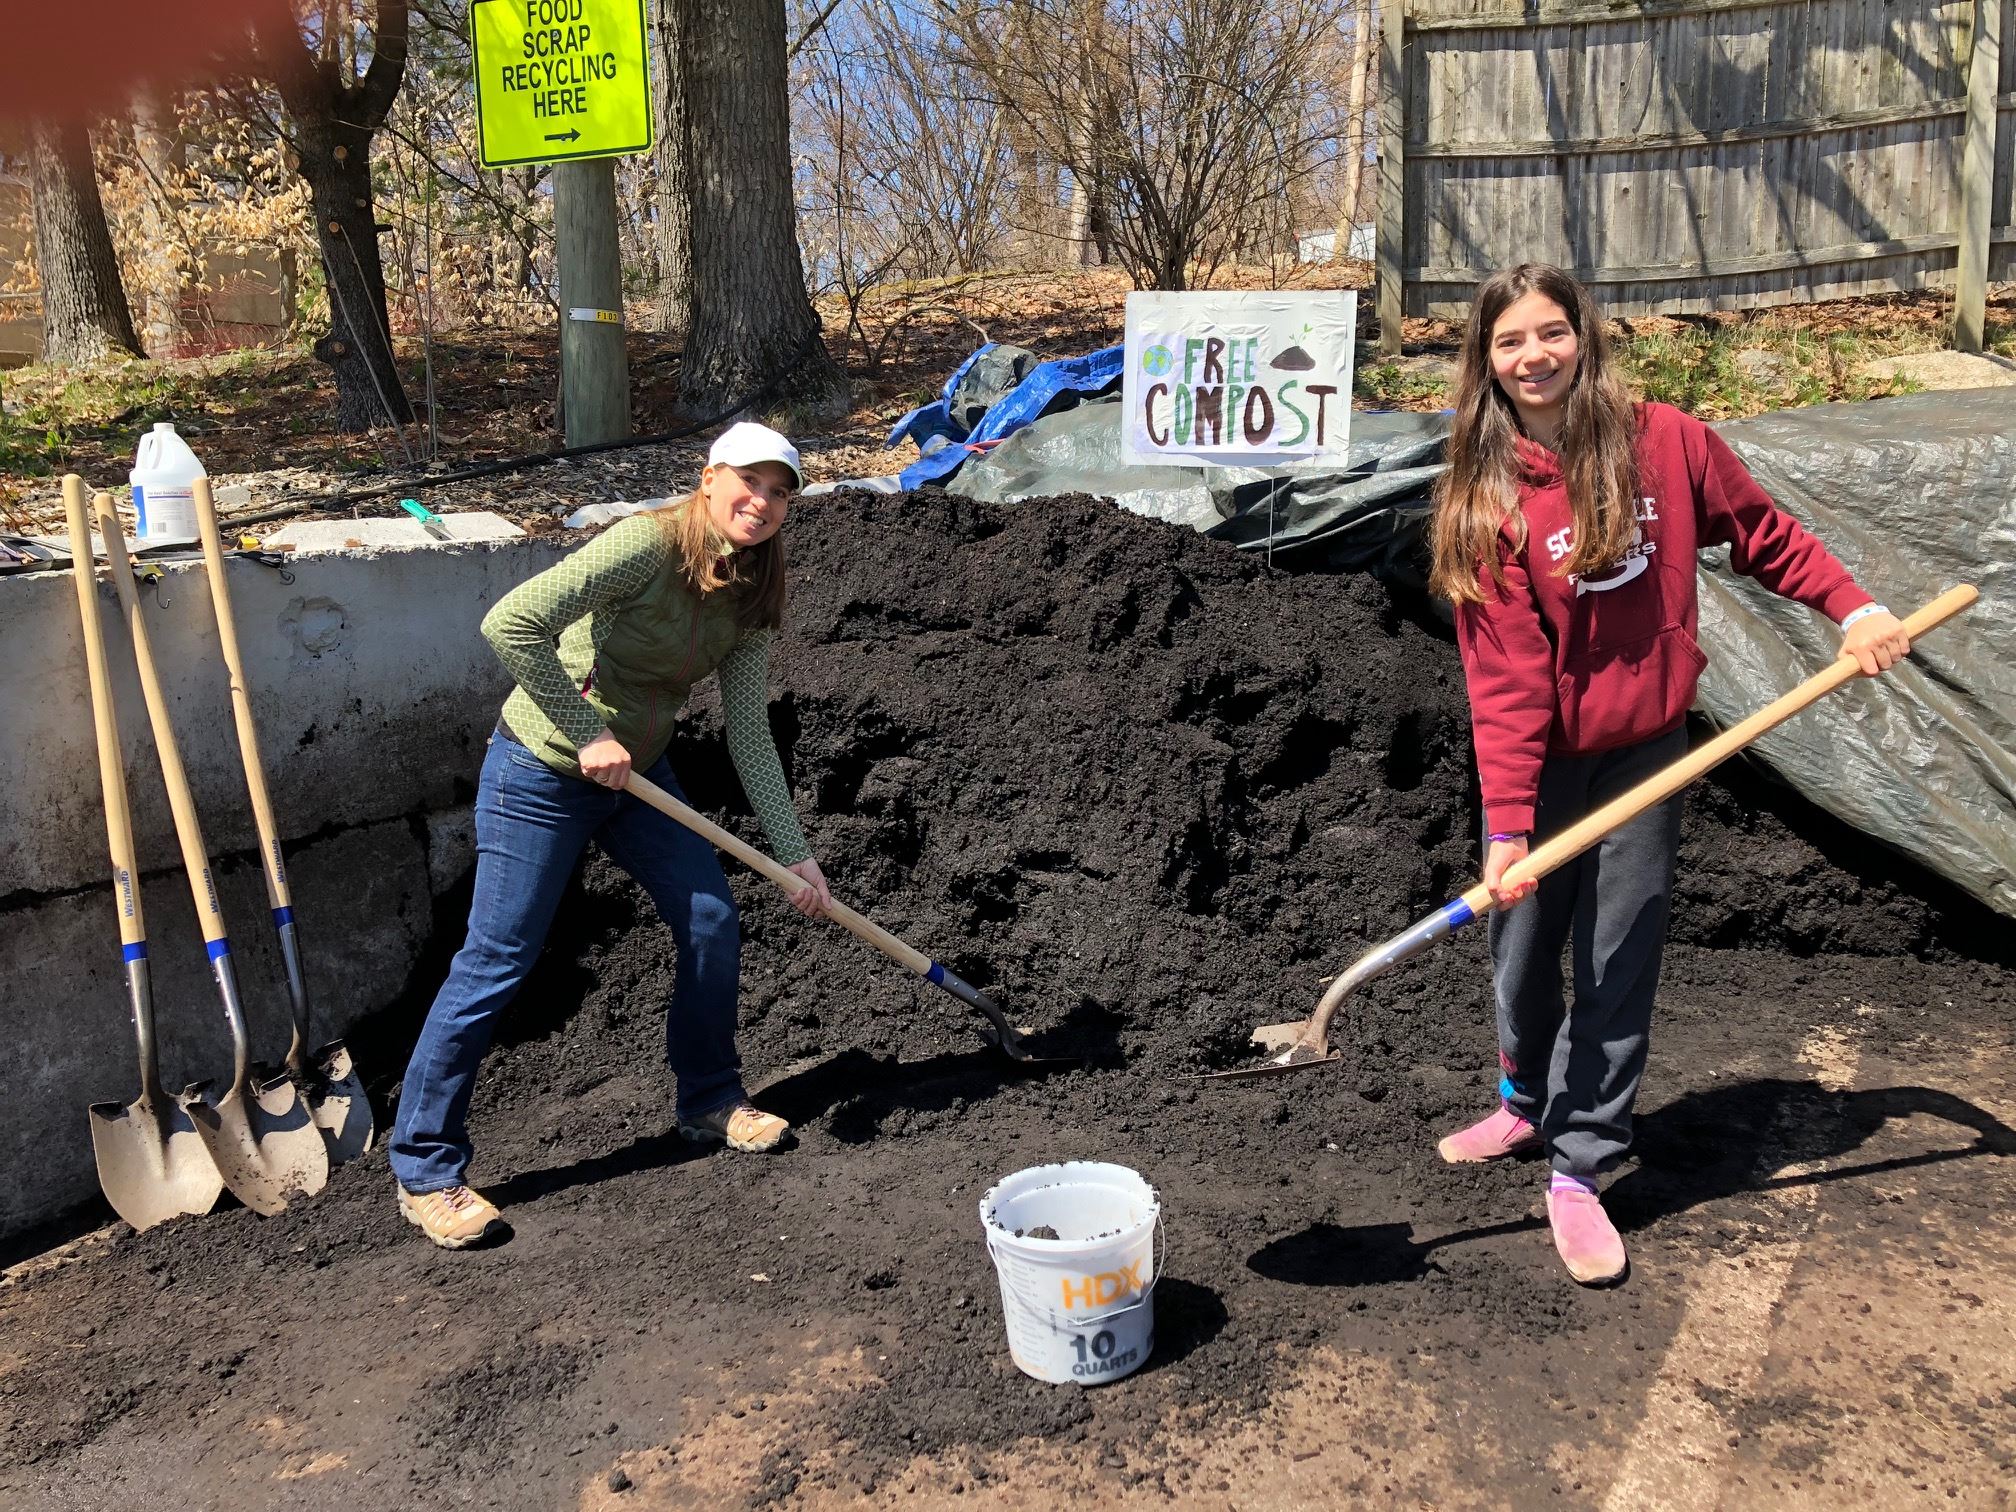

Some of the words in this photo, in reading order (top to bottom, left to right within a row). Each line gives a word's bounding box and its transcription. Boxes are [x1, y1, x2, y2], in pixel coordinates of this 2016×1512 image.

[527, 0, 583, 27] FOOD
[523, 24, 591, 59] SCRAP
[502, 52, 617, 92] RECYCLING
[533, 86, 588, 118] HERE
[1184, 337, 1258, 384] FREE
[1145, 379, 1338, 447] COMPOST
[272, 839, 285, 883] WESTWARD
[120, 870, 134, 918] WESTWARD
[202, 868, 219, 914] WESTWARD
[1061, 1257, 1144, 1310] HDX
[1069, 1330, 1116, 1363] 10
[1072, 1347, 1138, 1376] QUARTS
